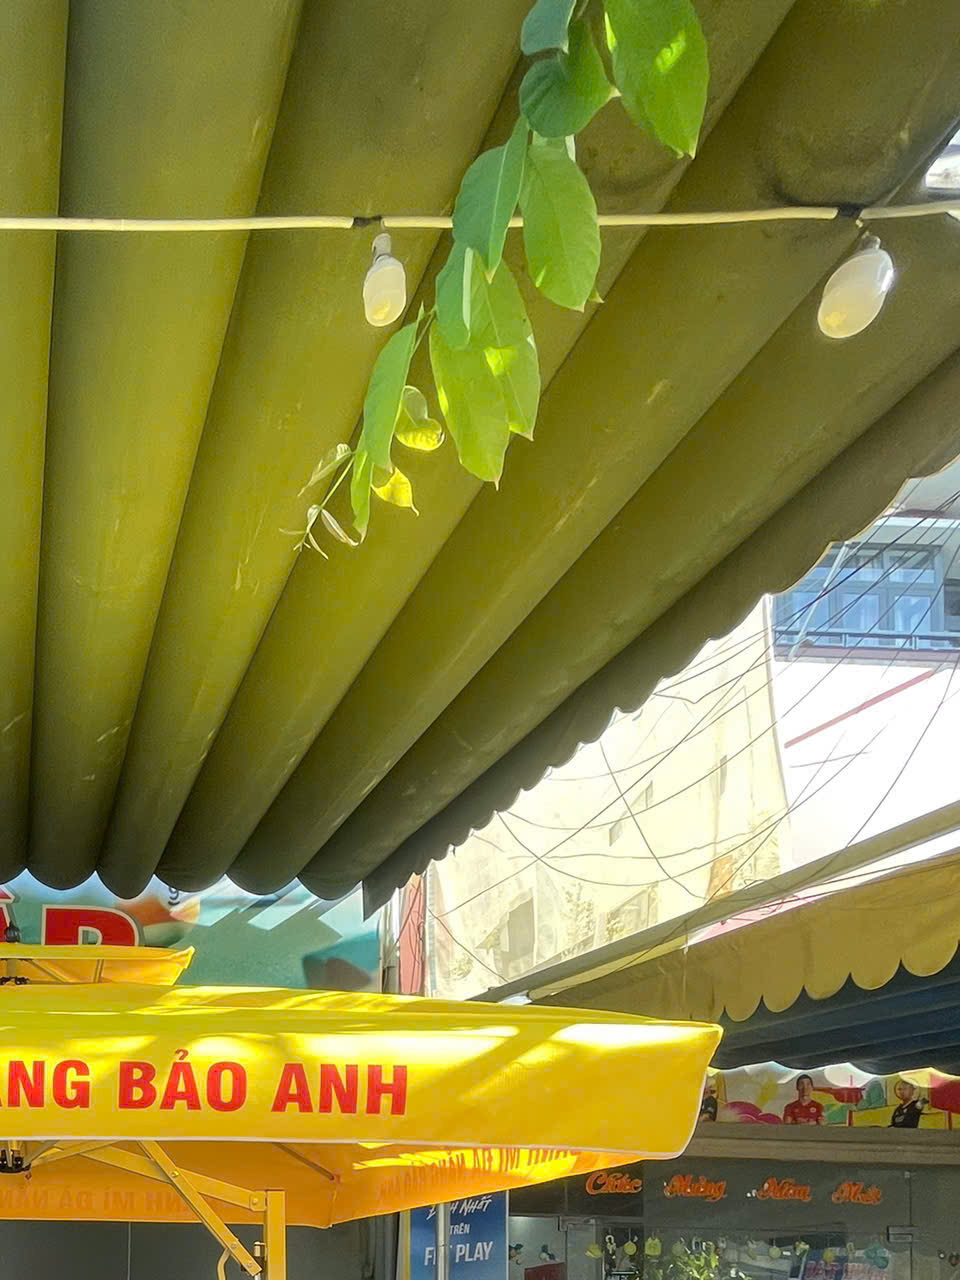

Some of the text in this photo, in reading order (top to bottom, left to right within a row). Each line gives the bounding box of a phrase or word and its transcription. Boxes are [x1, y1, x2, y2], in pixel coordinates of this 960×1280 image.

[118, 1048, 249, 1112] BẢO
[271, 1062, 409, 1115] ANH
[449, 1222, 471, 1235] TRÊN
[455, 1241, 494, 1263] PLAY
